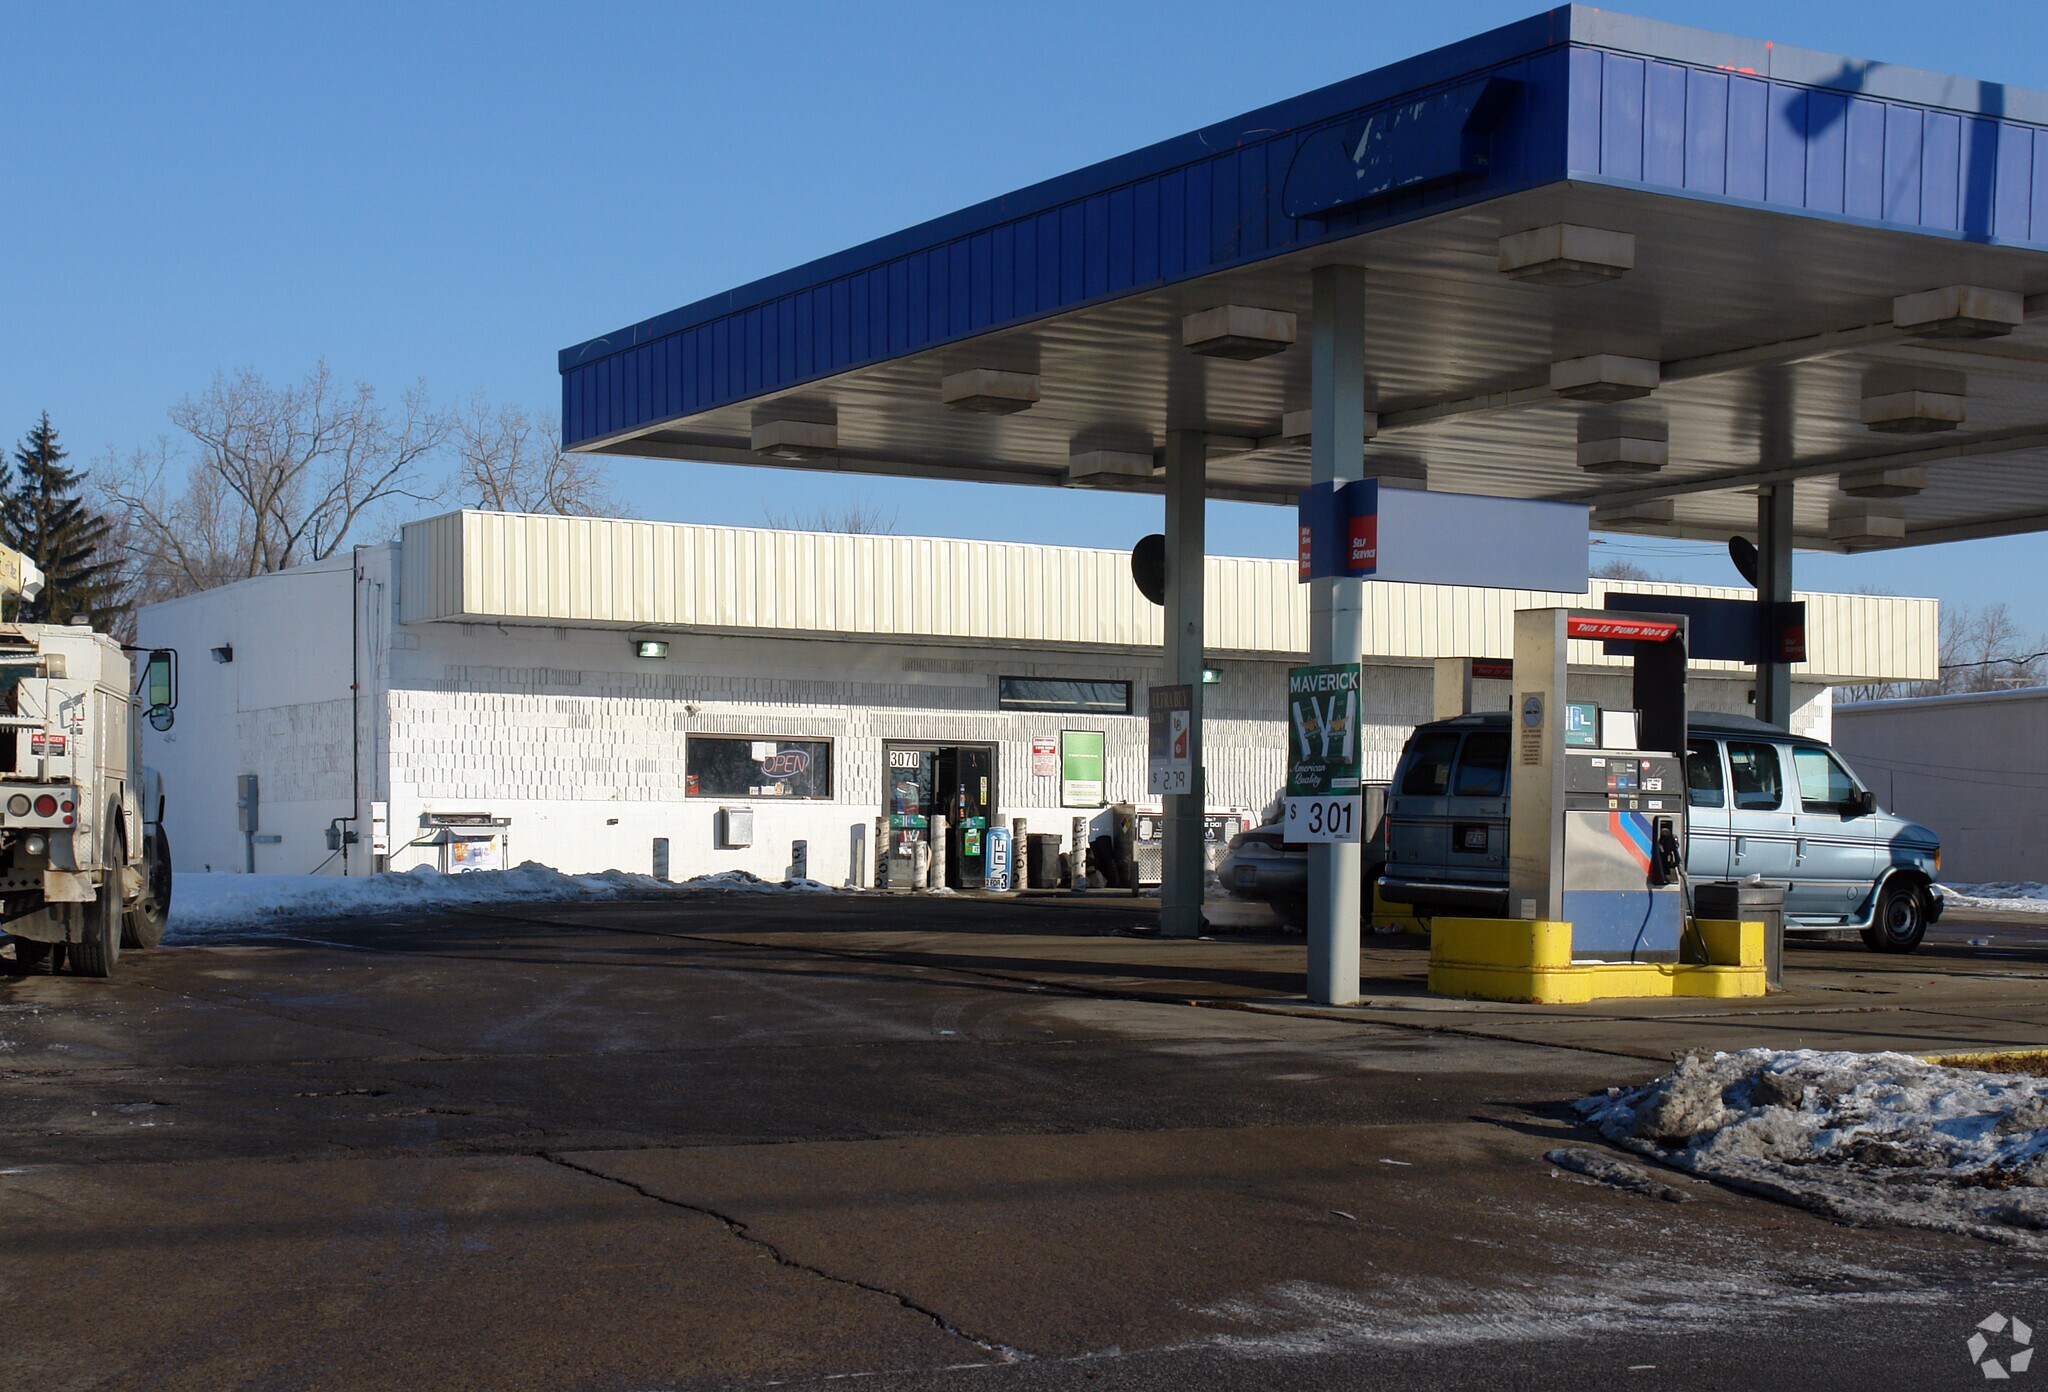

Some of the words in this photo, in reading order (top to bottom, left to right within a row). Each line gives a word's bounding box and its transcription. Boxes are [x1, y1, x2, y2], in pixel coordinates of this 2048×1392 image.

[1577, 624, 1598, 632] THIS
[1599, 625, 1610, 633] IS
[1612, 625, 1639, 635] PUMP
[1290, 672, 1358, 693] MAVERICK
[763, 755, 806, 773] OPEN
[890, 752, 919, 767] 3070
[1289, 761, 1327, 773] American
[1153, 772, 1158, 783] $
[1163, 771, 1185, 790] 2.79
[1294, 773, 1322, 788] Quality
[1290, 803, 1297, 820] $
[1308, 802, 1352, 836] 3.01
[990, 836, 1006, 879] NOS
[1001, 874, 1008, 889] 3
